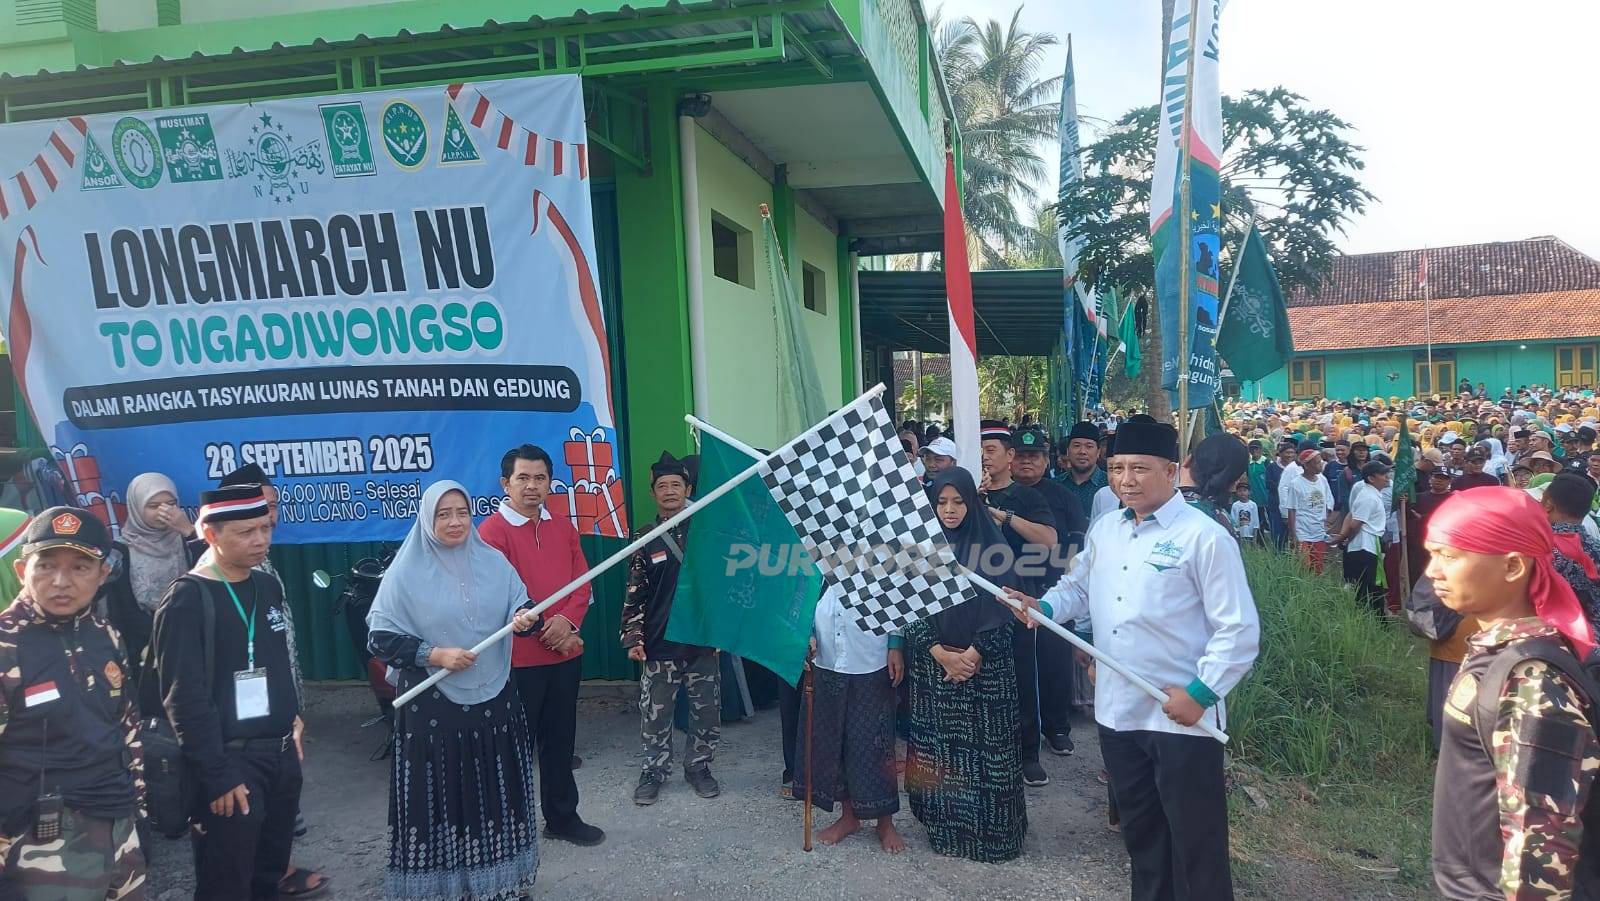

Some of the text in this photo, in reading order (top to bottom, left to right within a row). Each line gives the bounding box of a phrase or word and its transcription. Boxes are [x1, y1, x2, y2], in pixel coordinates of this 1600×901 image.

[160, 117, 205, 128] MUSLIMAT
[335, 163, 362, 173] FATAYAT
[84, 174, 119, 187] ANSOR
[253, 182, 309, 198] N U
[84, 206, 495, 310] LONGMARCH NU
[100, 301, 503, 369] TO NGADIWONGSO
[72, 378, 571, 418] DALAM RANGKA TASYAKURAN LUNAS TANAH DAN GEDUNG
[205, 436, 433, 479] 28 SEPTEMBER 2025
[317, 482, 350, 501] WIB
[366, 480, 421, 499] Selesai
[282, 503, 306, 523] NU
[310, 501, 367, 522] LOANO
